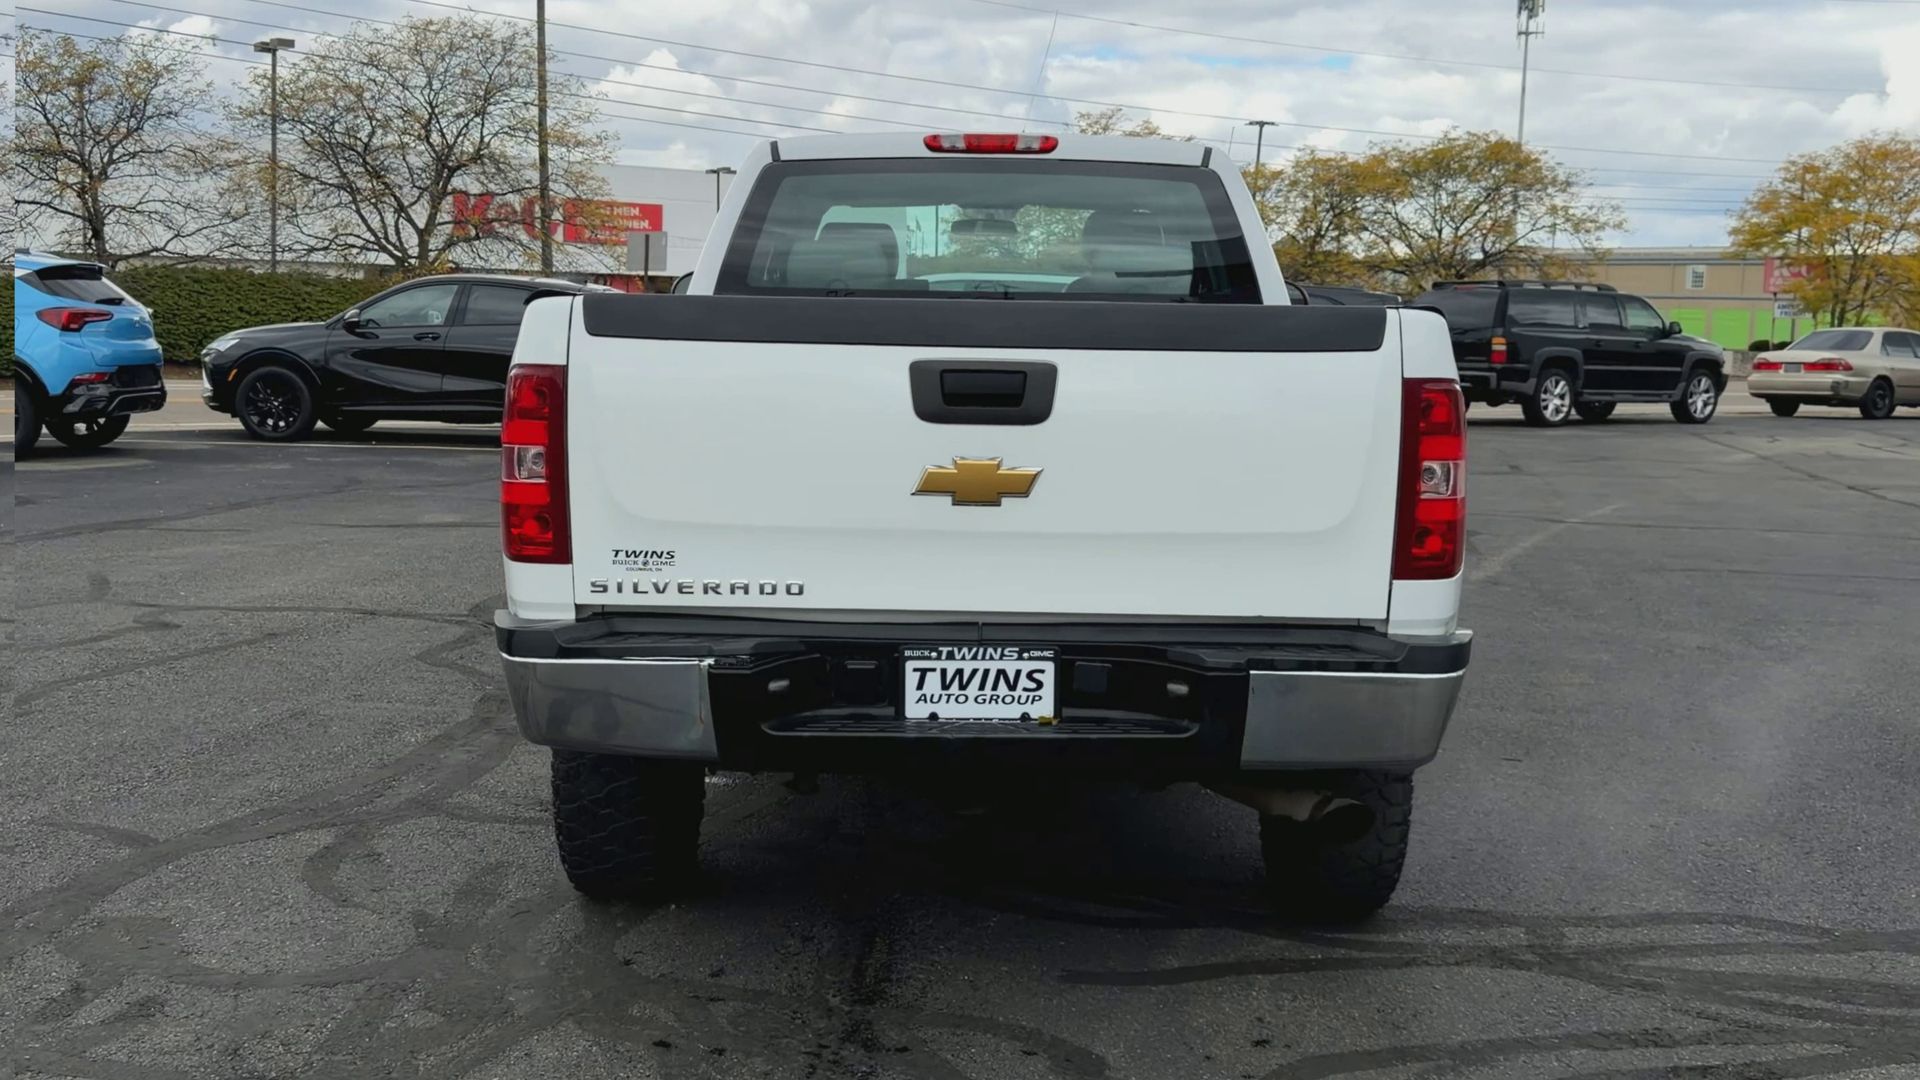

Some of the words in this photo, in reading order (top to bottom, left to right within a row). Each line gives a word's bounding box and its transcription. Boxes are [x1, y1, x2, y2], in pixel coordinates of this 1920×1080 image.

[611, 549, 676, 560] TWINS
[590, 578, 805, 596] SILVERADO
[938, 647, 1020, 660] TWINS
[912, 667, 1046, 693] TWINS
[915, 693, 969, 705] AUTO
[973, 694, 1043, 706] GROUP
